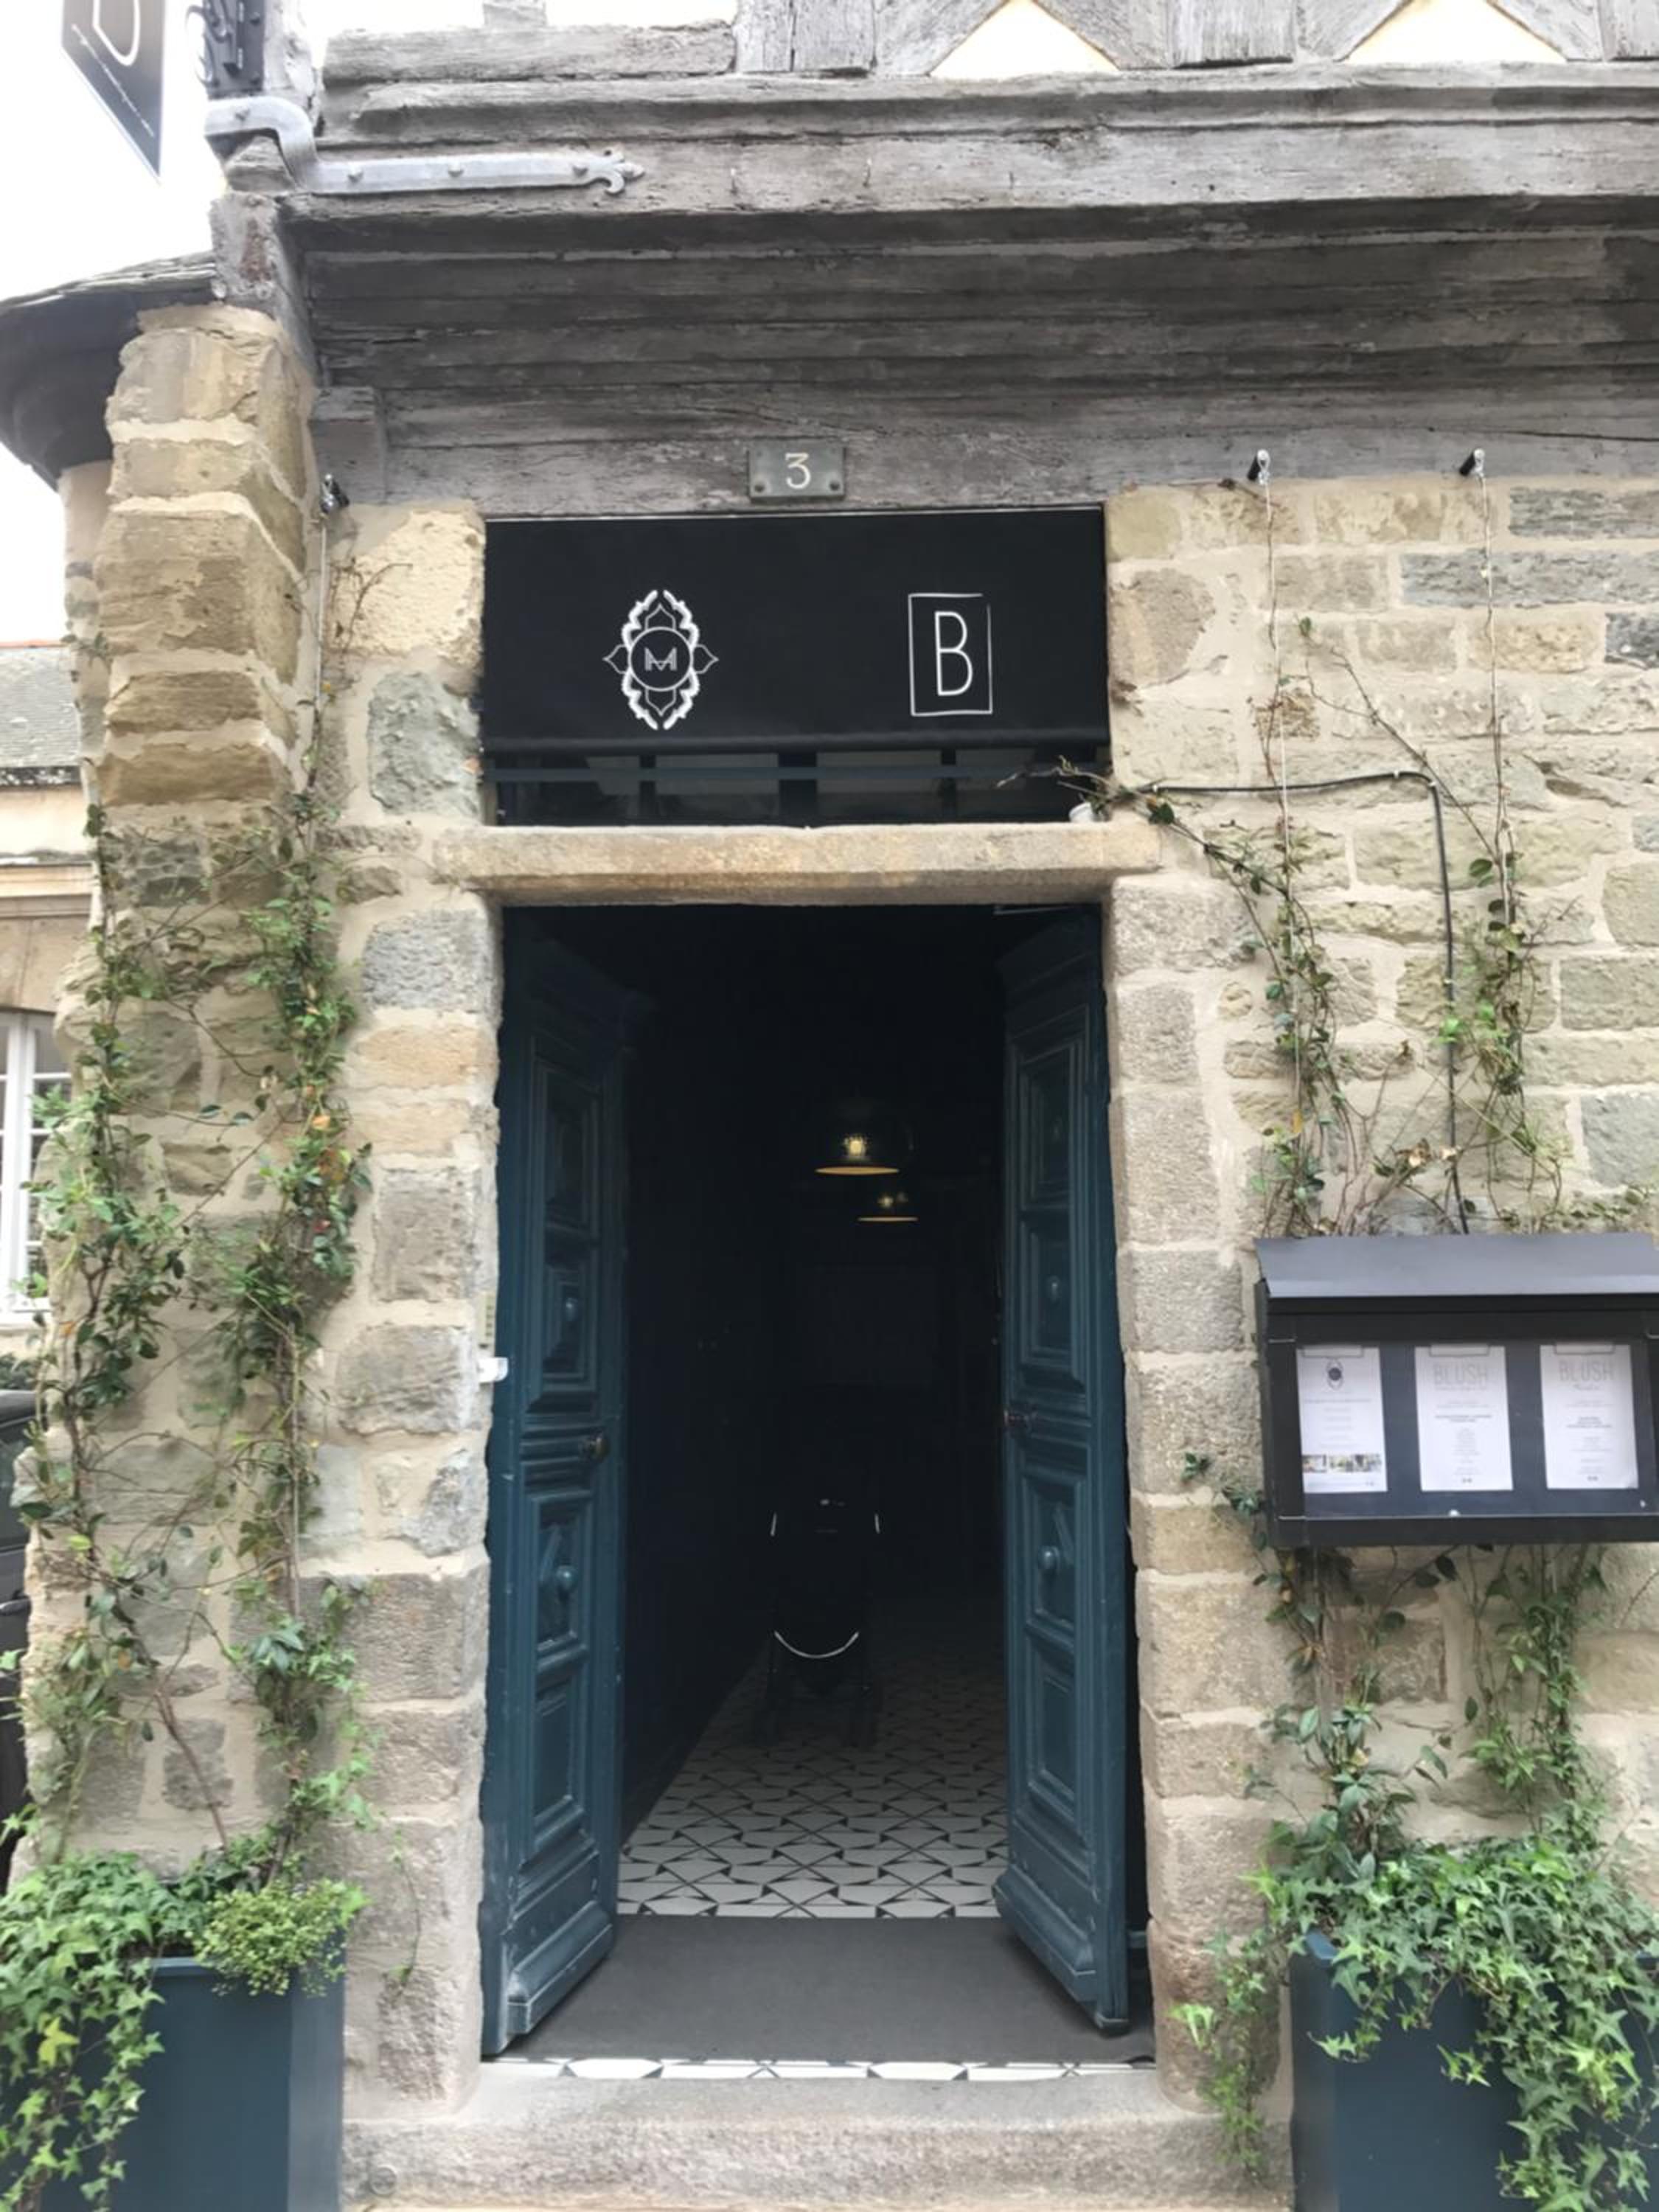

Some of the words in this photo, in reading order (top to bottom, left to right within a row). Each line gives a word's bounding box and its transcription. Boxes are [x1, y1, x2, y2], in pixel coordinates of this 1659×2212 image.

[785, 452, 812, 490] 3
[644, 647, 678, 672] M
[933, 610, 973, 696] B
